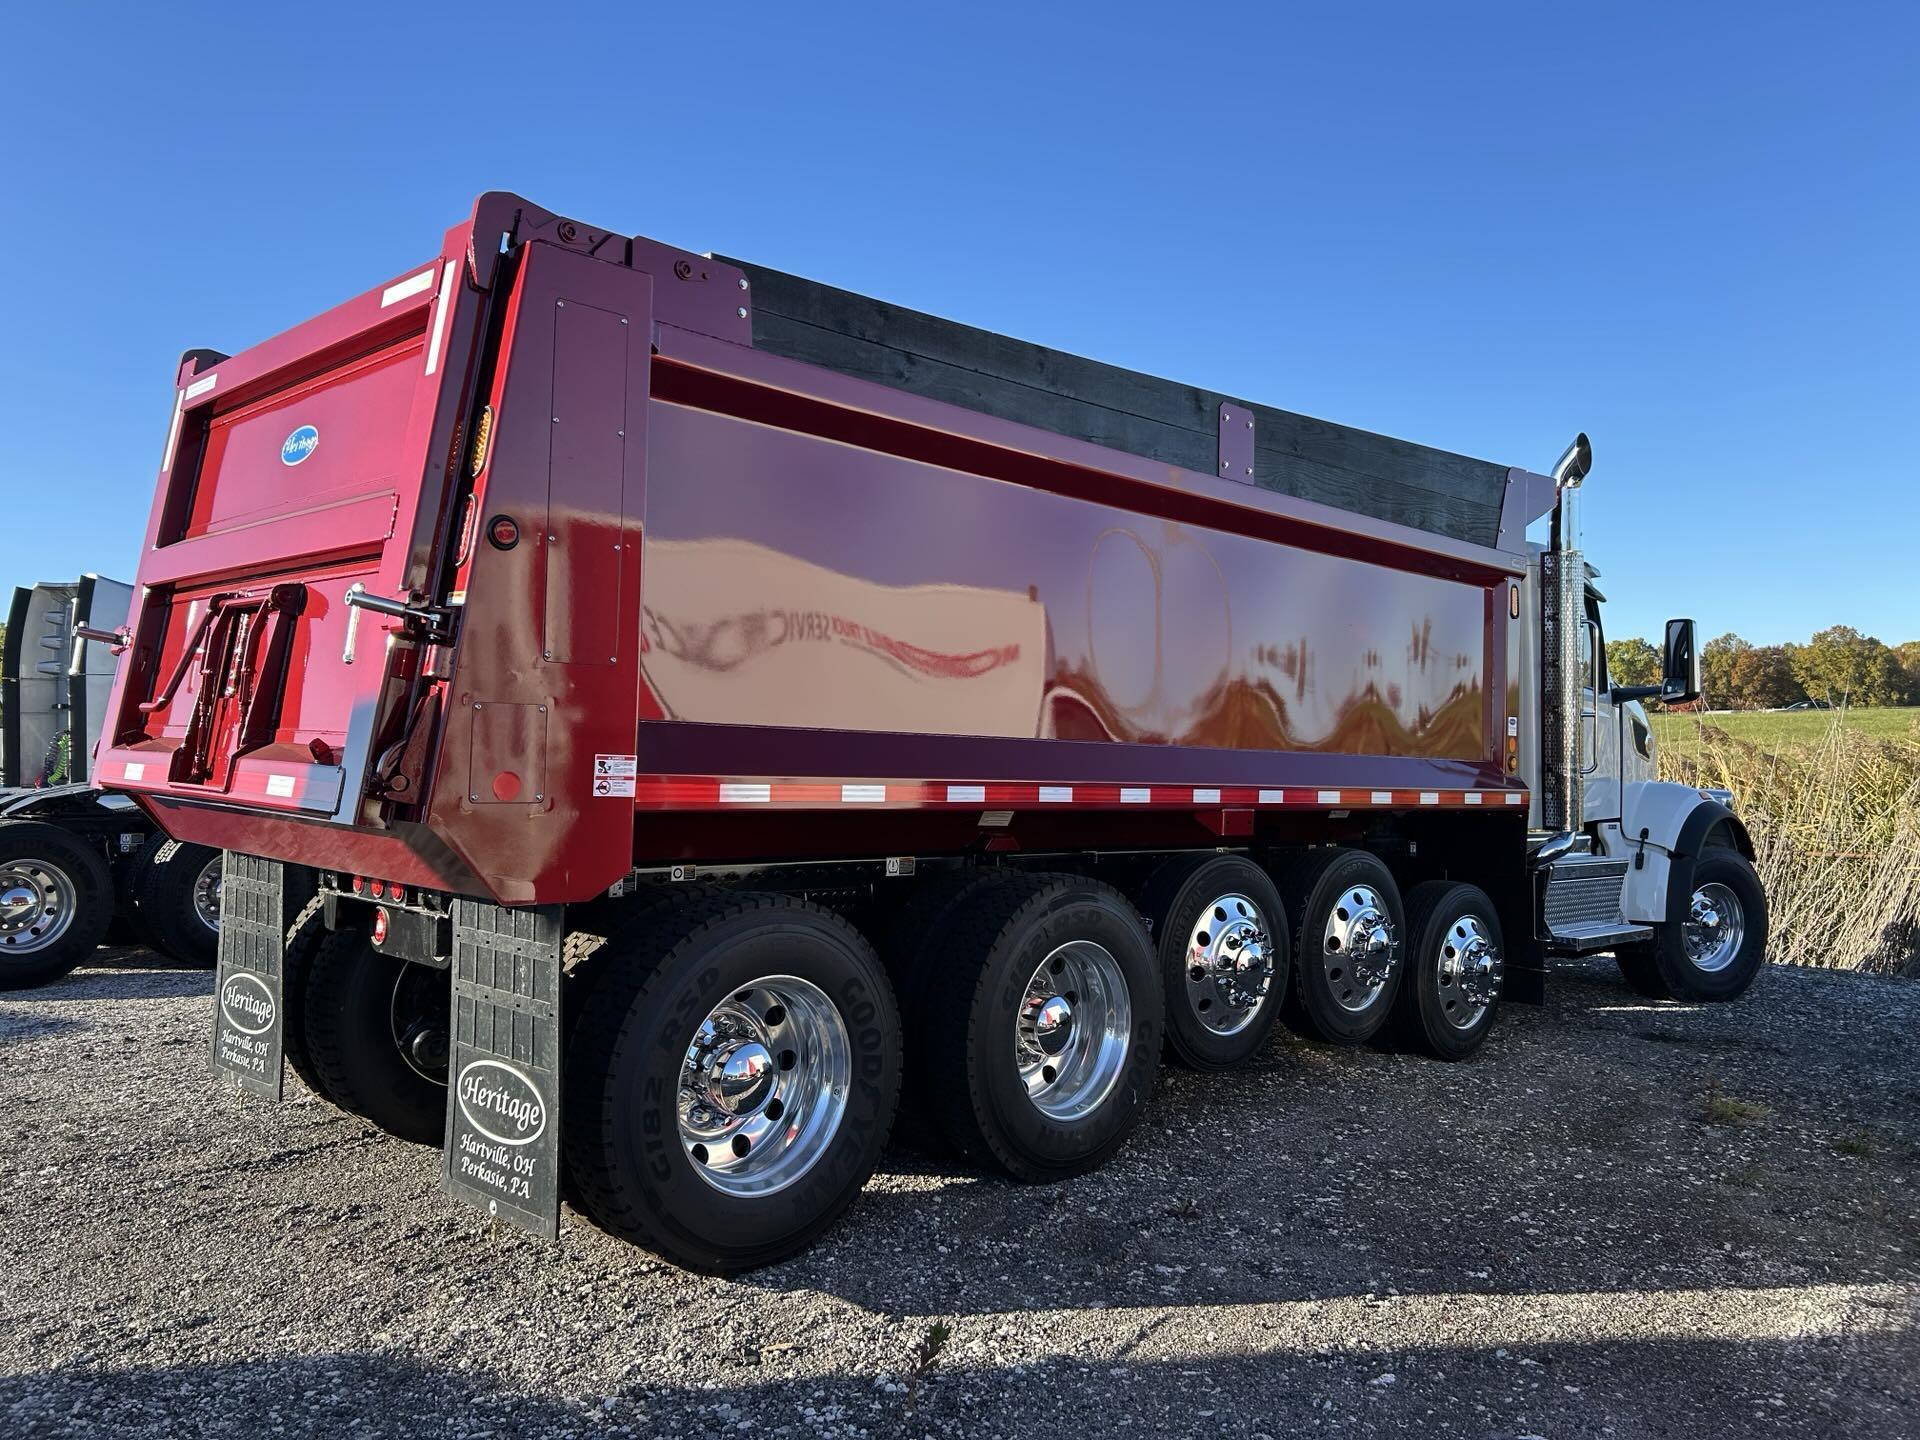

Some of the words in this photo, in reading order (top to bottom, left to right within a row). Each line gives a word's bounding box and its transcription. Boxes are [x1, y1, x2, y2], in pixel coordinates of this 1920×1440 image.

[225, 986, 272, 1023] Heritage
[657, 967, 719, 1051] RSD
[221, 1029, 254, 1053] Hartville,
[254, 1041, 269, 1056] OH
[221, 1046, 251, 1070] Perkasie,
[252, 1057, 265, 1073] PA
[462, 1077, 540, 1131] Heritage
[643, 1075, 672, 1182] G182
[460, 1134, 511, 1170] Hartville,
[513, 1155, 536, 1177] OH
[460, 1157, 508, 1192] Perkasie,
[510, 1177, 530, 1198] PA
